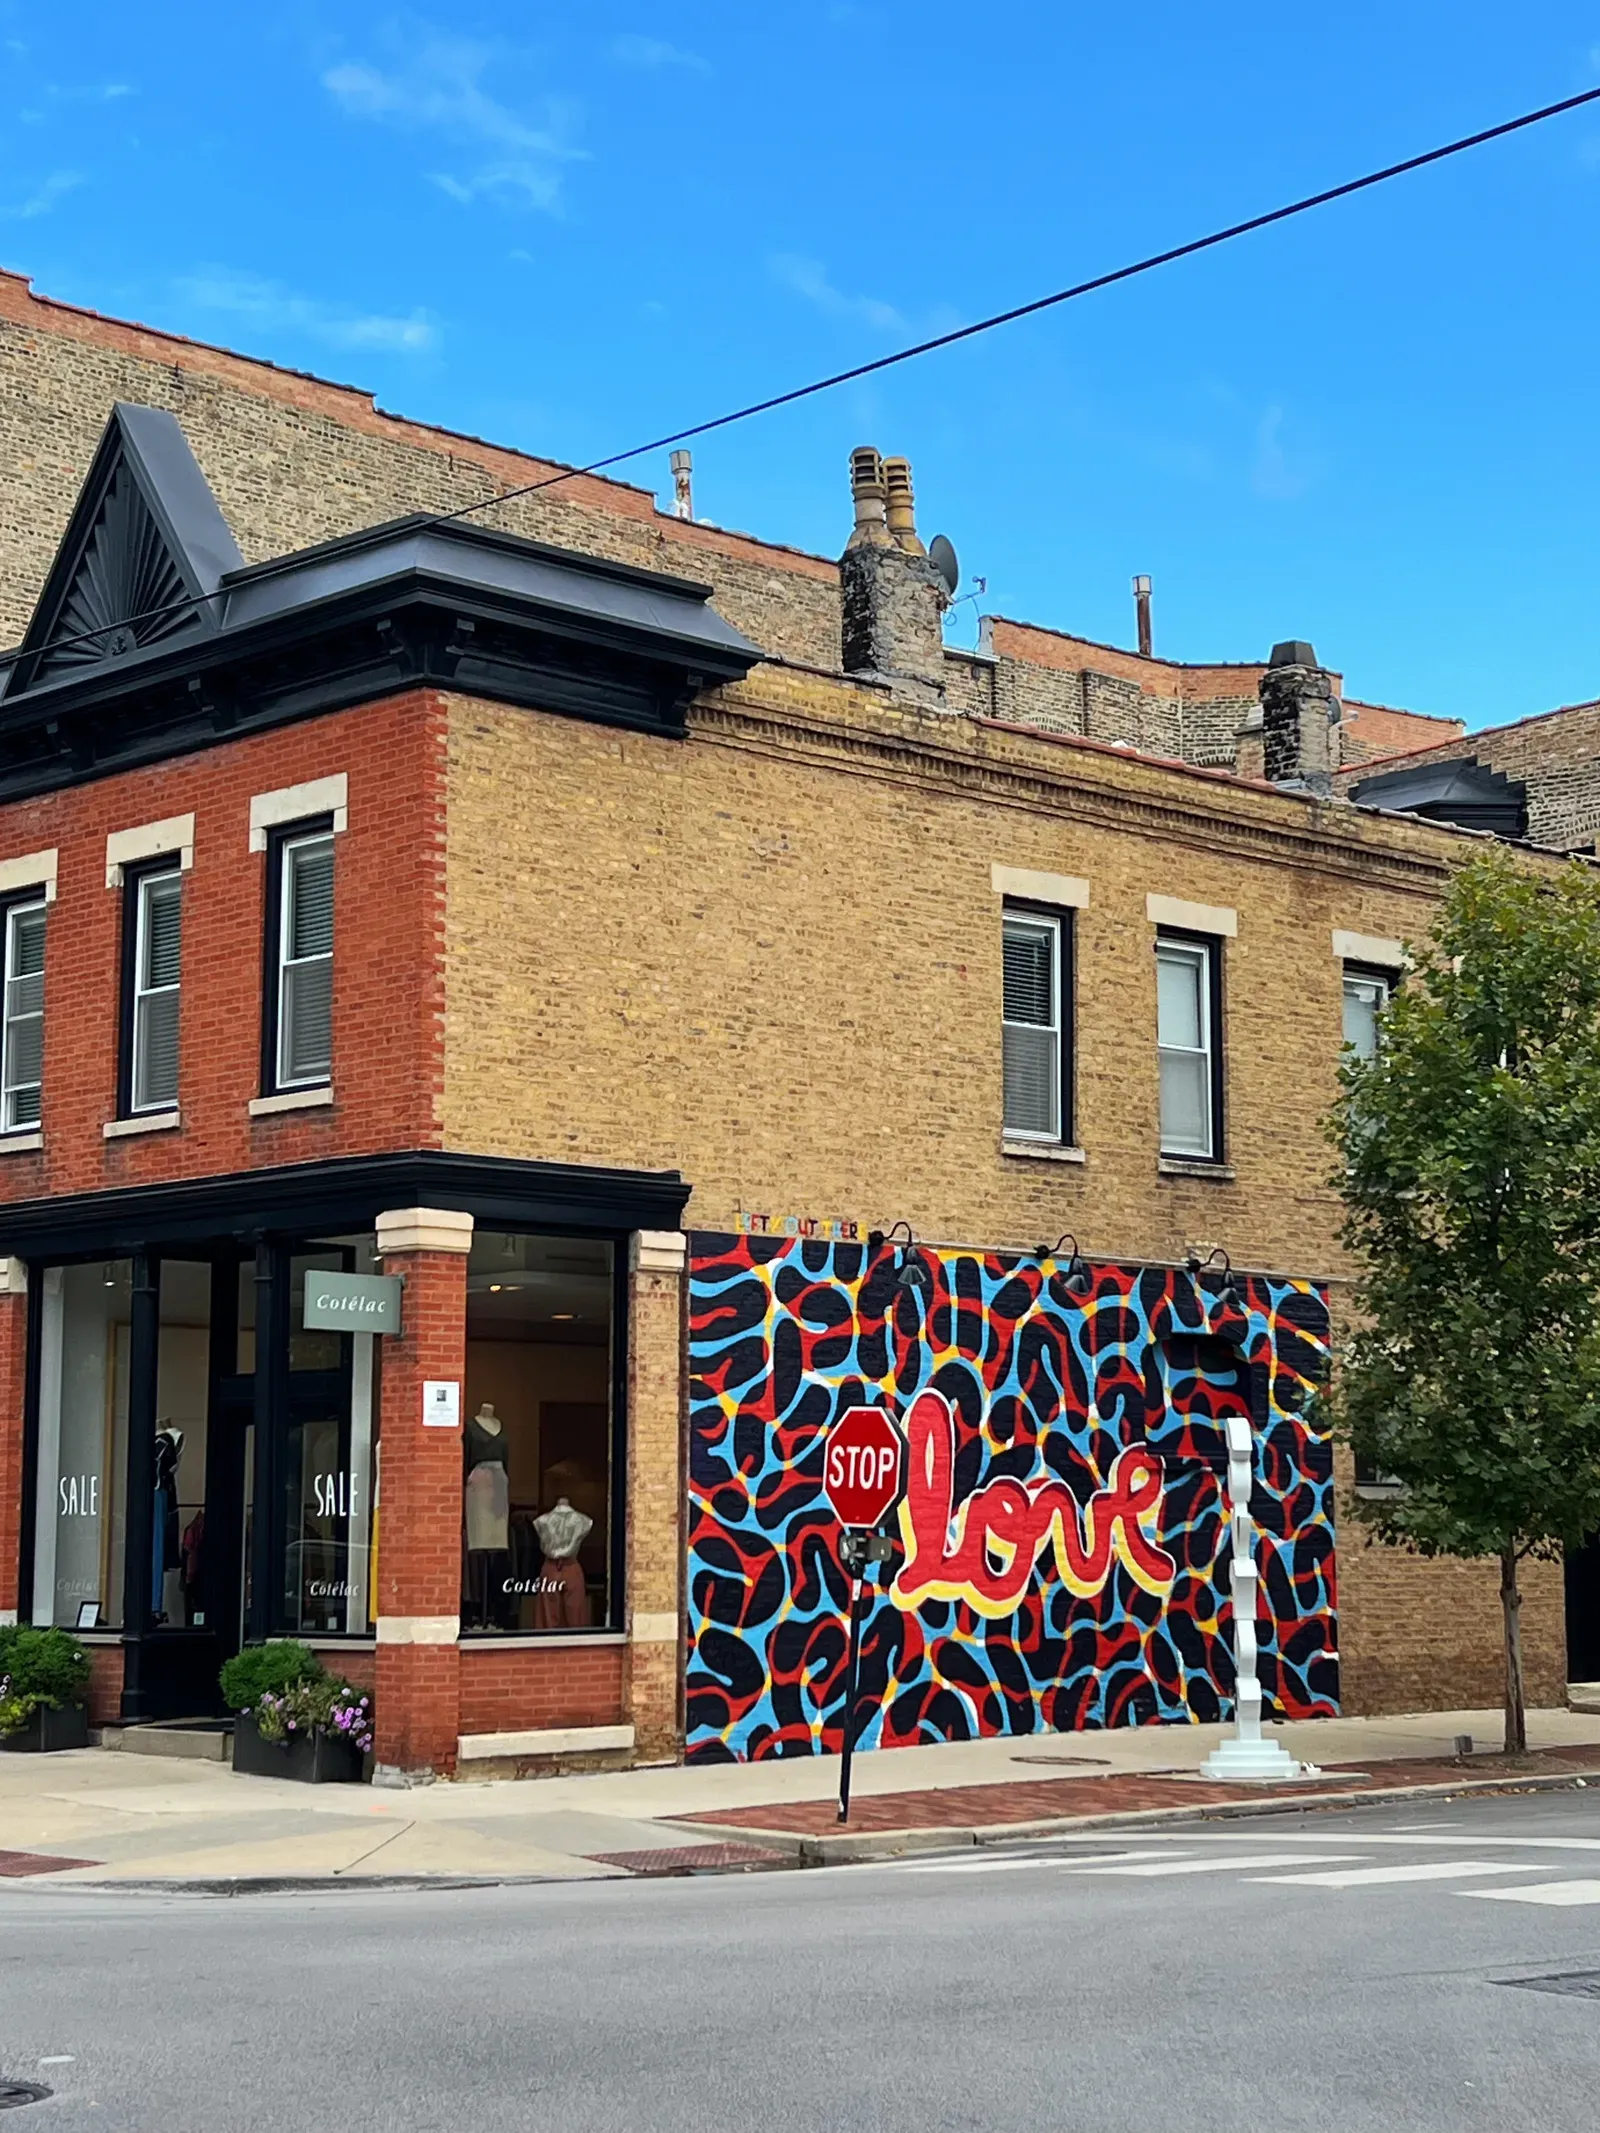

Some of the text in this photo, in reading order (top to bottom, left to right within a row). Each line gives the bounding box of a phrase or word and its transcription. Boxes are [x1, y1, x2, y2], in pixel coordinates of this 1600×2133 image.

[785, 1215, 818, 1237] OUT
[316, 1294, 386, 1313] Cotélac
[828, 1444, 895, 1490] STOP
[59, 1474, 98, 1516] SALE
[314, 1471, 359, 1517] SALE
[310, 1580, 360, 1597] Cotélac
